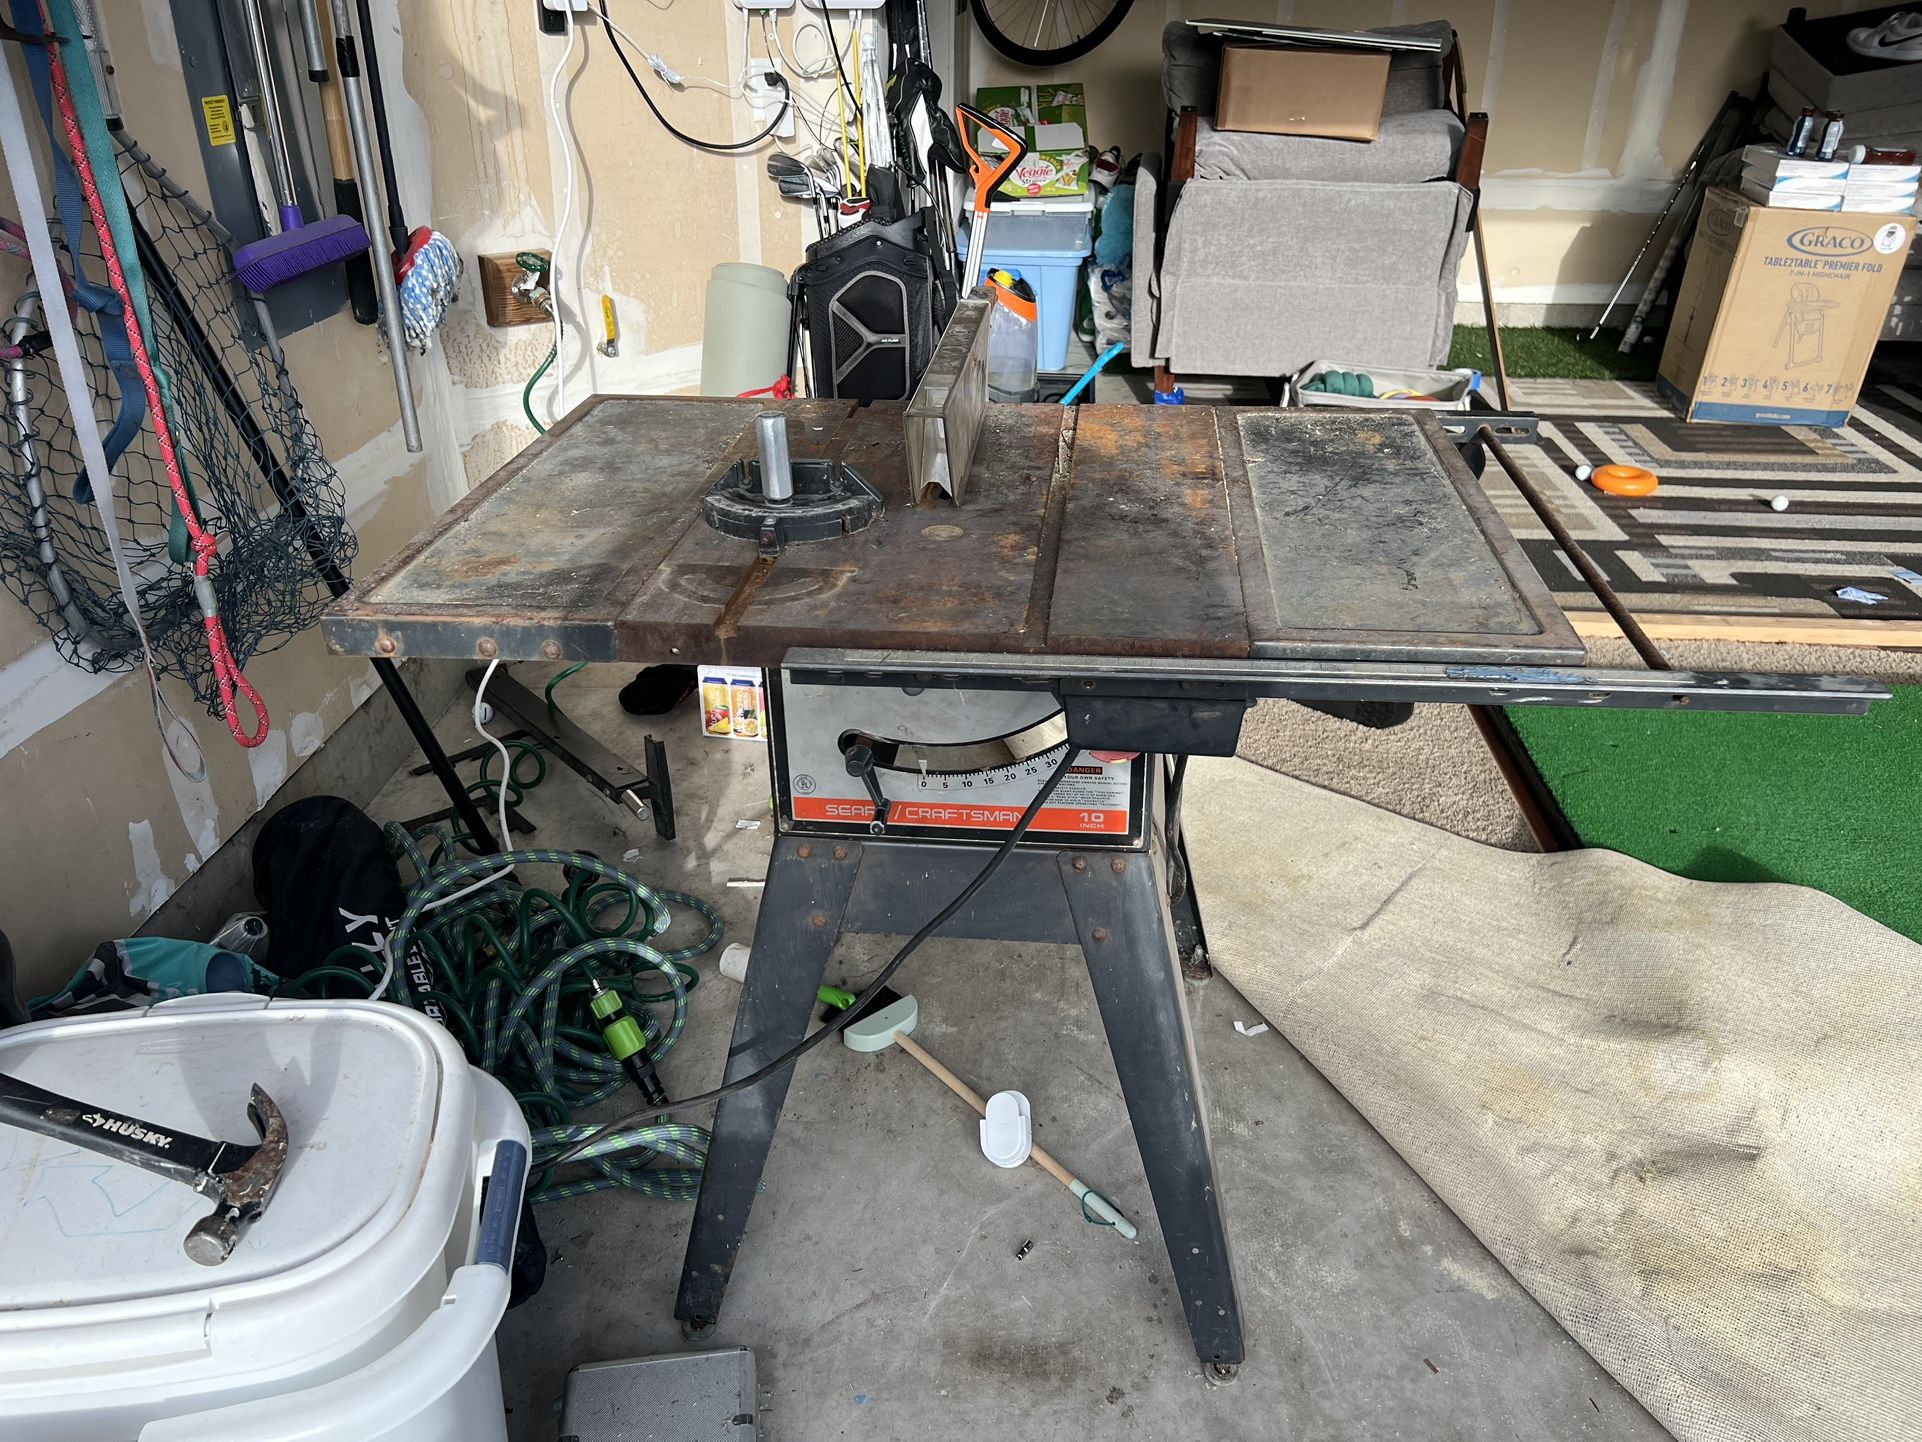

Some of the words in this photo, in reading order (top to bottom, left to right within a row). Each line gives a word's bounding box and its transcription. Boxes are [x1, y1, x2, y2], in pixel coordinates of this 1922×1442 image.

[1015, 166, 1053, 180] Veggie
[1799, 230, 1865, 250] GRACO
[1823, 260, 1860, 272] PREMIER
[1861, 263, 1883, 273] FOLD
[1721, 377, 1728, 386] 2
[1741, 378, 1747, 388] 3
[1762, 380, 1768, 390] 4
[1781, 381, 1788, 390] 5
[1803, 383, 1809, 392] 6
[1825, 384, 1831, 394] 7
[962, 780, 973, 788] 10
[984, 778, 994, 786] 15
[1004, 774, 1016, 782] 20
[1025, 767, 1037, 775] 25
[1045, 759, 1058, 768] 30
[825, 804, 876, 817] SEAR
[1080, 812, 1104, 822] 10
[103, 1118, 173, 1149] HUSKY
